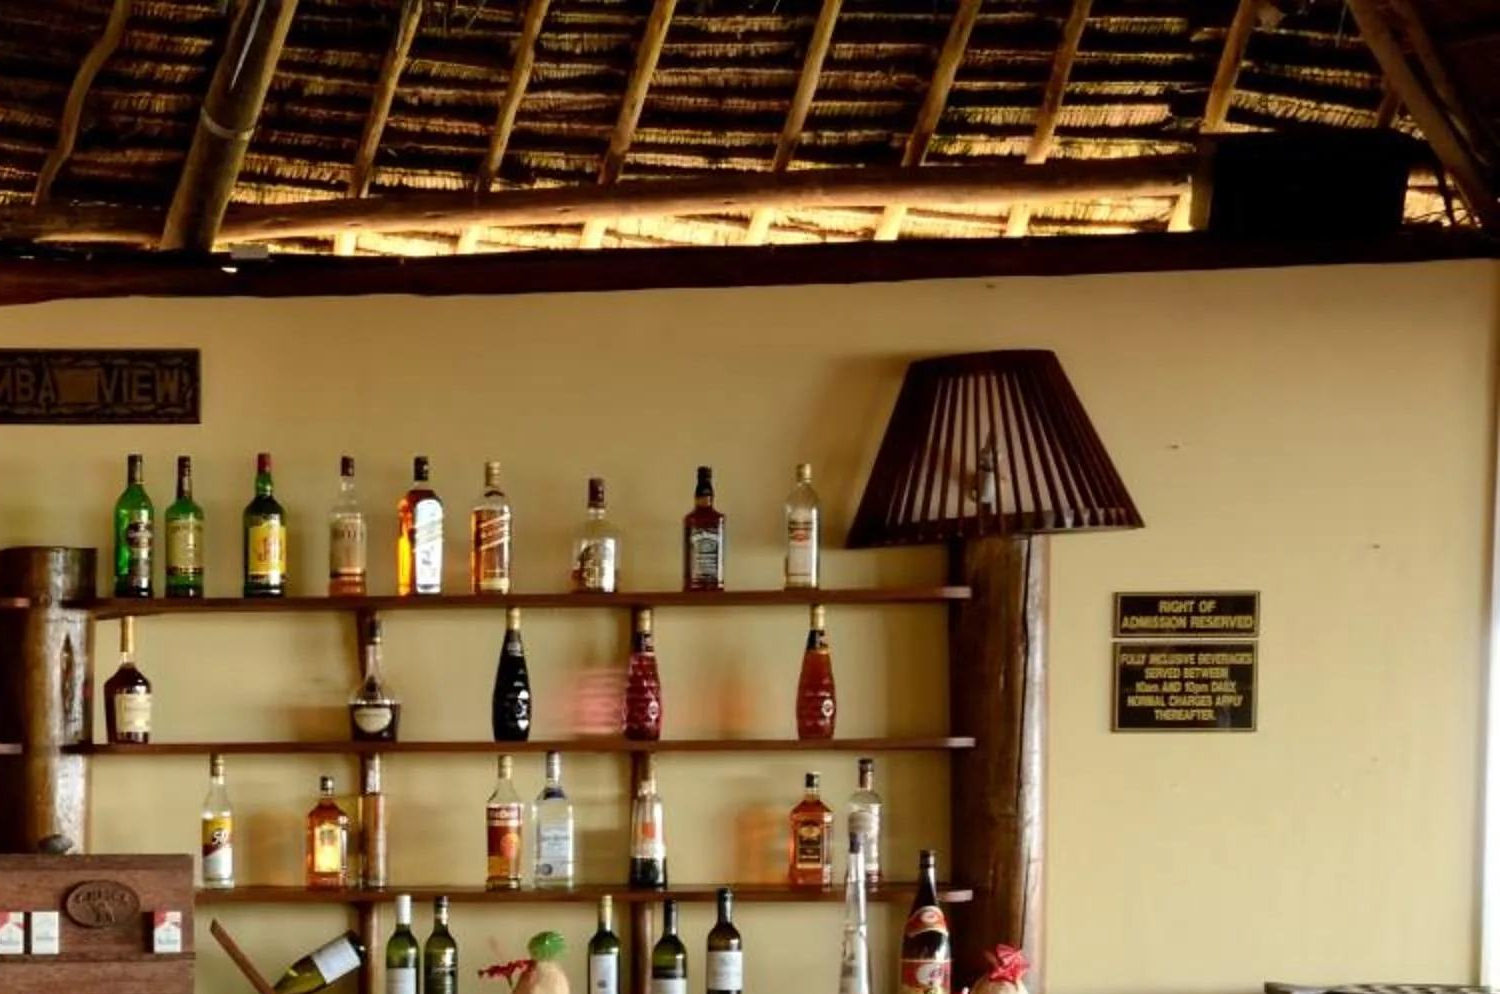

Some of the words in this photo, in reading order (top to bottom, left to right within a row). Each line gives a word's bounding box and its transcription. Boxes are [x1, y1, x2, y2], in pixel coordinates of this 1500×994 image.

[97, 366, 180, 404] VIEW
[1158, 600, 1195, 613] RIGHT
[1198, 600, 1217, 613] OF
[1121, 615, 1187, 629] ADMISSION
[1189, 615, 1254, 629] RESERVED
[1144, 667, 1181, 679] SERVED
[1183, 667, 1229, 679] BETWEEN
[1161, 681, 1182, 692] AND
[1127, 695, 1166, 707] NORMAL
[1168, 695, 1213, 707] CHARGES
[1215, 695, 1244, 707] APPLY
